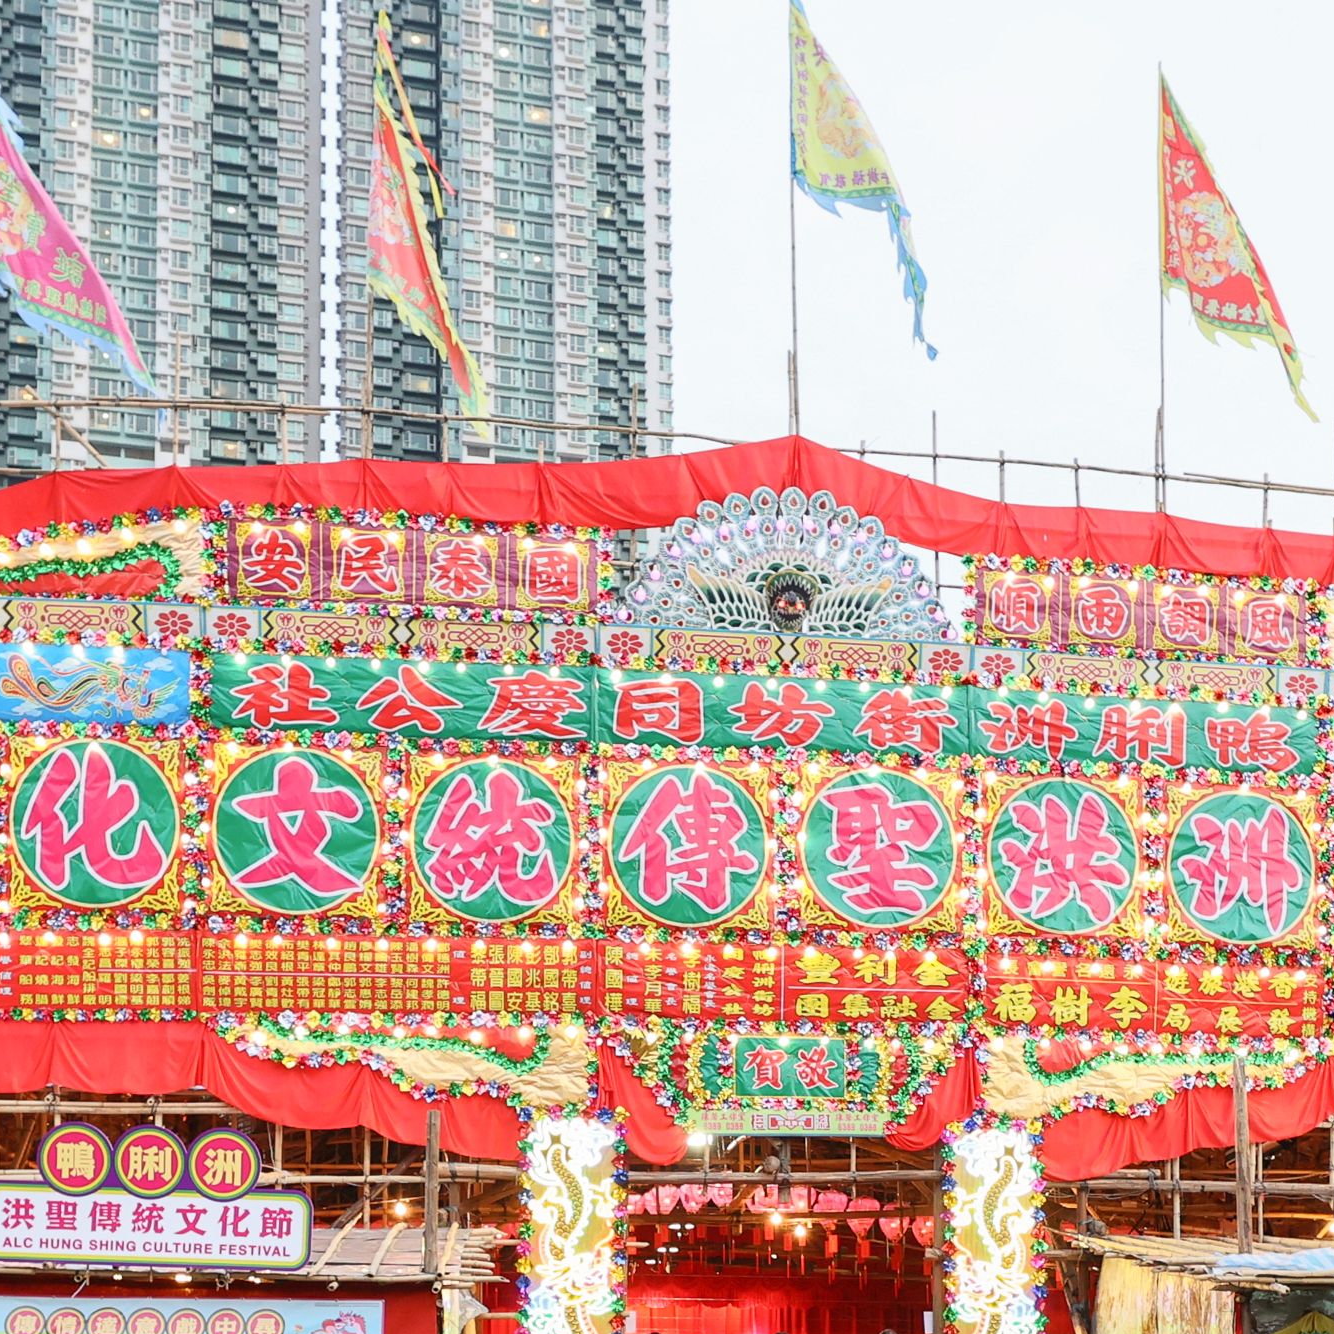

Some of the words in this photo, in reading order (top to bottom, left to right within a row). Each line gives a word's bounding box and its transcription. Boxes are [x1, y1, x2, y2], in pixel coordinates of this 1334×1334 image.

[240, 529, 583, 603] 國泰民安
[990, 581, 1293, 650] 風調雨順
[229, 661, 1300, 773] 鴨脷洲街坊同慶公社
[992, 982, 1148, 1029] 李樹福
[1163, 1005, 1297, 1036] 發展局
[743, 1044, 839, 1090] 敬賀
[56, 1141, 245, 1187] 鴨脷洲
[2, 1198, 294, 1239] 洪聖傳統文化節
[3, 1236, 34, 1249] ALC
[39, 1238, 83, 1251] HUNG
[88, 1239, 136, 1253] SHING
[142, 1241, 214, 1255] CULTURE
[219, 1243, 291, 1257] FESTIVAL
